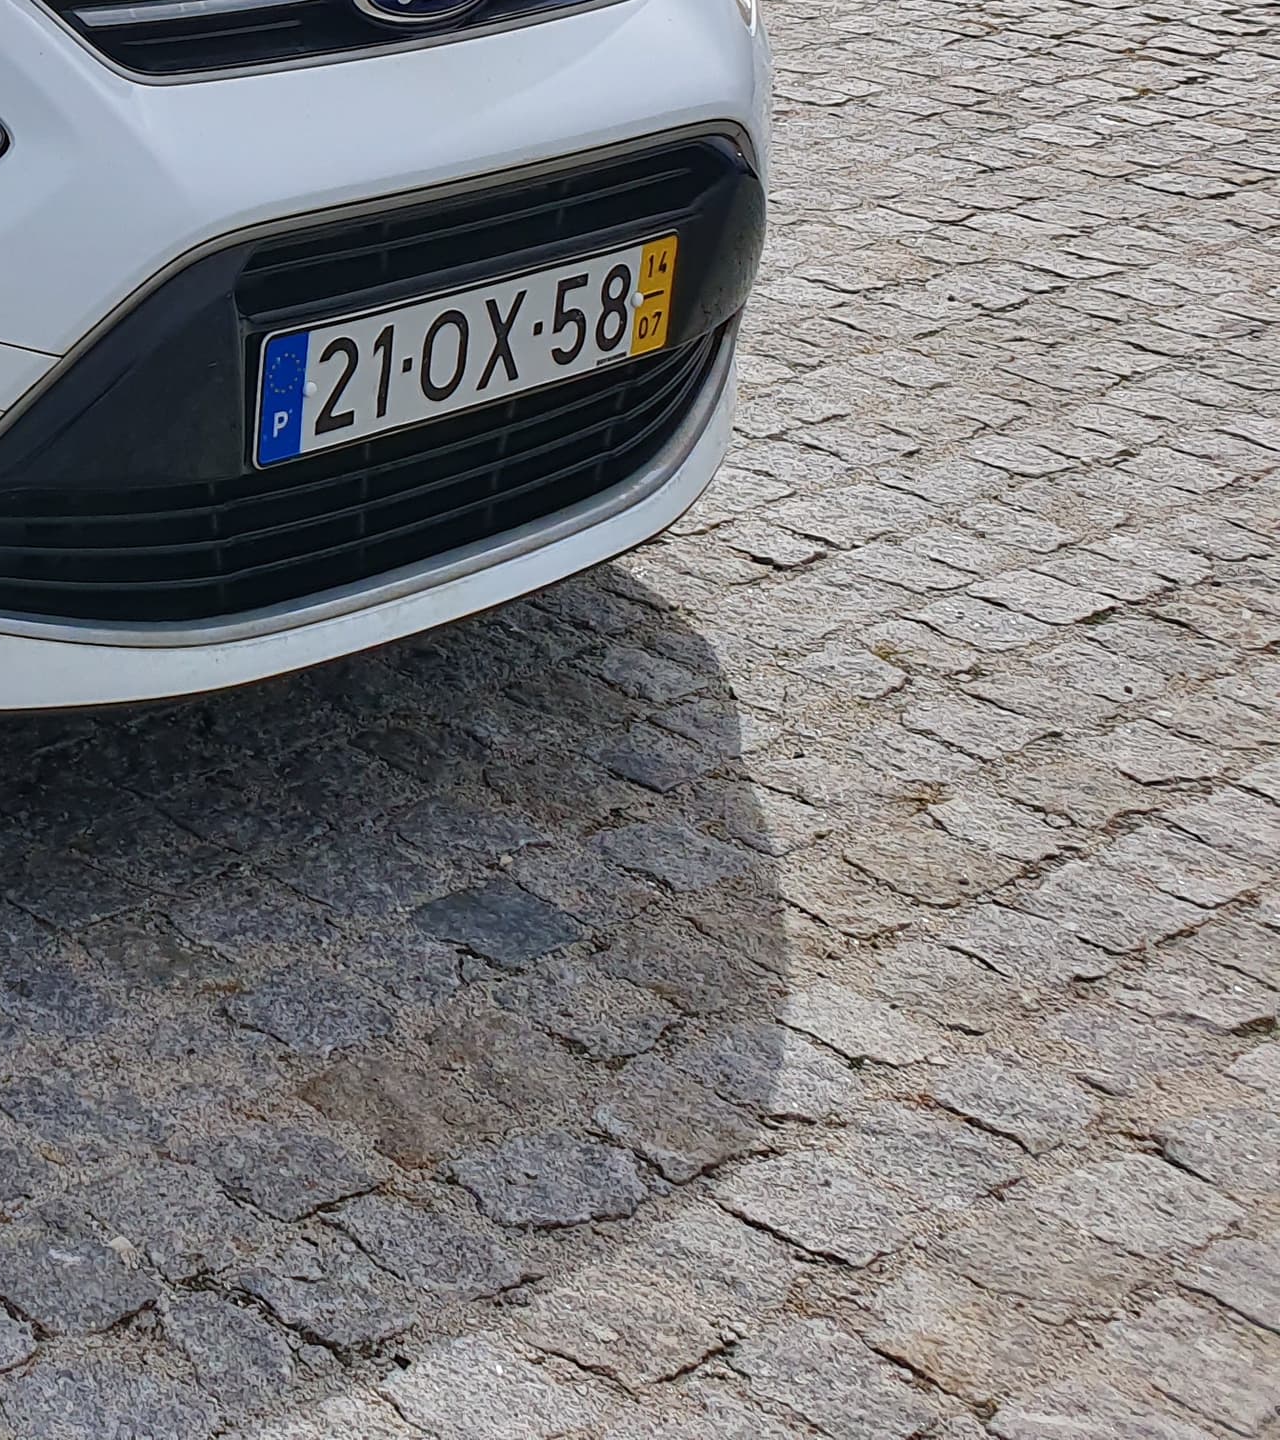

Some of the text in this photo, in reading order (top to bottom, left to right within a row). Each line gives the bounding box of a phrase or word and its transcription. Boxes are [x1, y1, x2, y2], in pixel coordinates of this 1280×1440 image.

[648, 251, 667, 278] 14
[638, 311, 662, 339] 07
[272, 410, 289, 438] P
